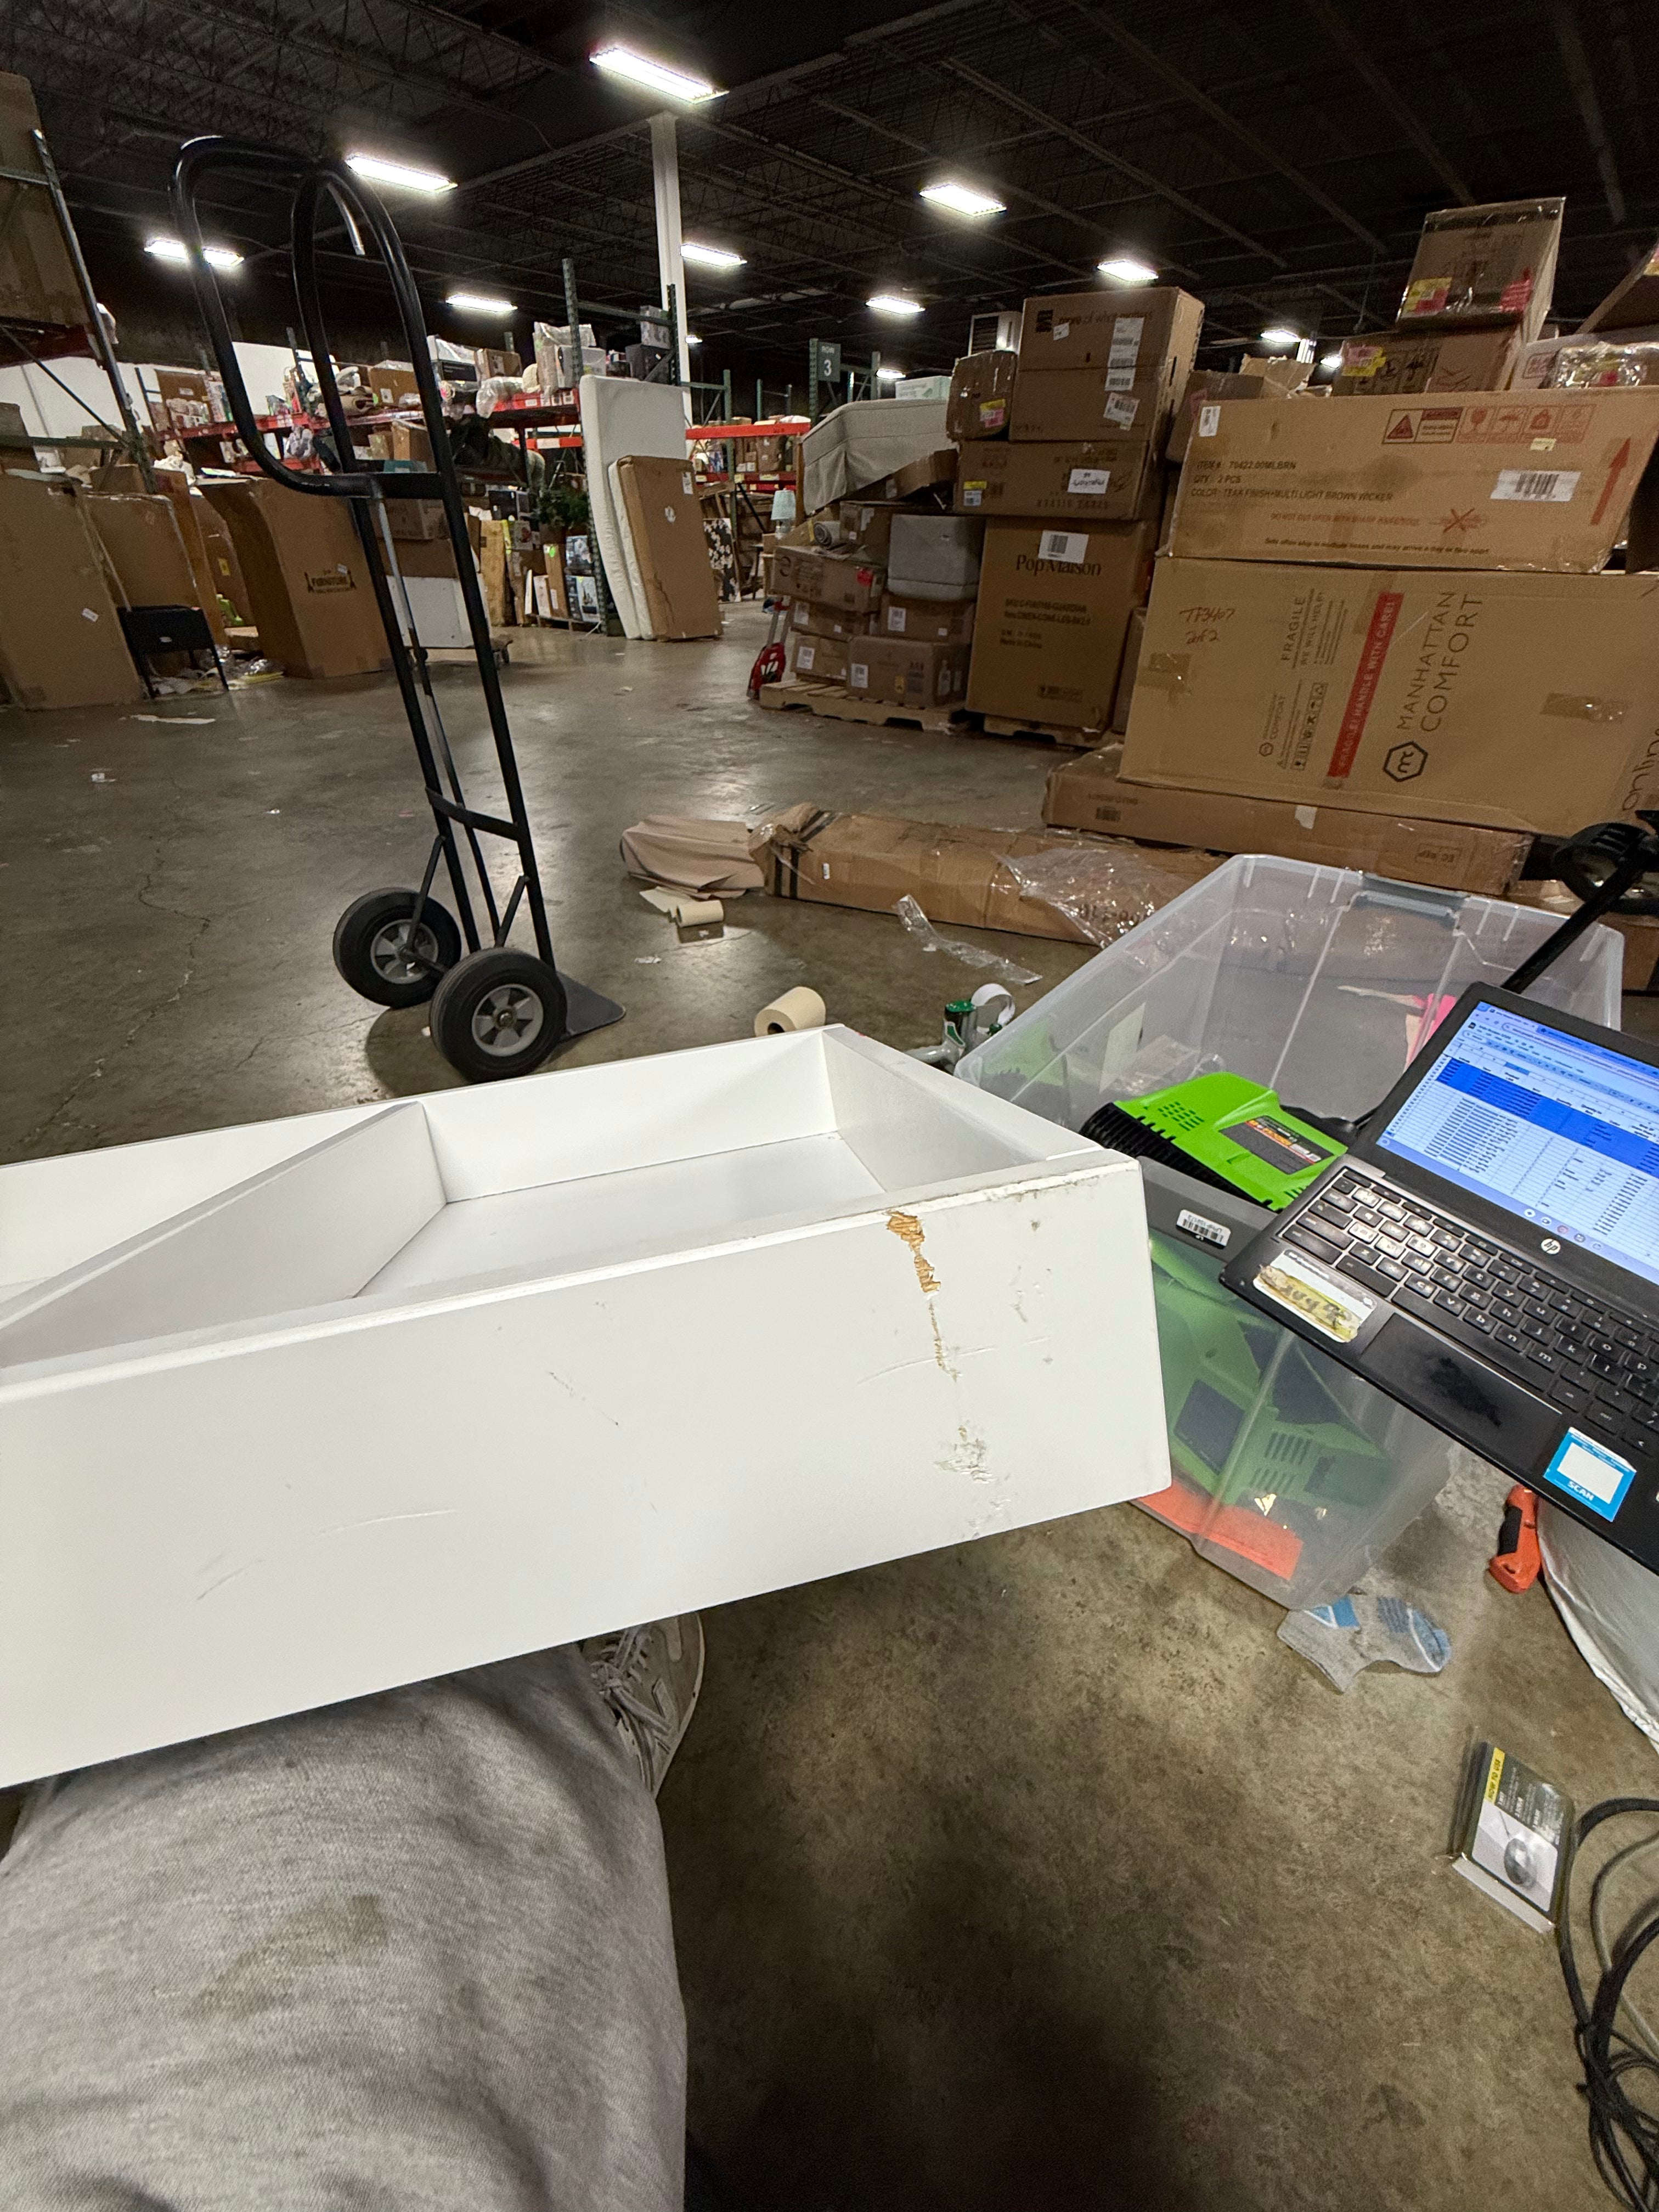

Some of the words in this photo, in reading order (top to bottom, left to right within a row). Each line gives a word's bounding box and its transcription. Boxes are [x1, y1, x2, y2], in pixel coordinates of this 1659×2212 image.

[824, 359, 832, 376] 3
[1016, 554, 1045, 576] Pop
[1281, 596, 1306, 661] FRAGILE
[1396, 591, 1457, 730] MANHATTAN
[1420, 594, 1483, 732] COMFORT
[1567, 1481, 1595, 1503] SCAN
